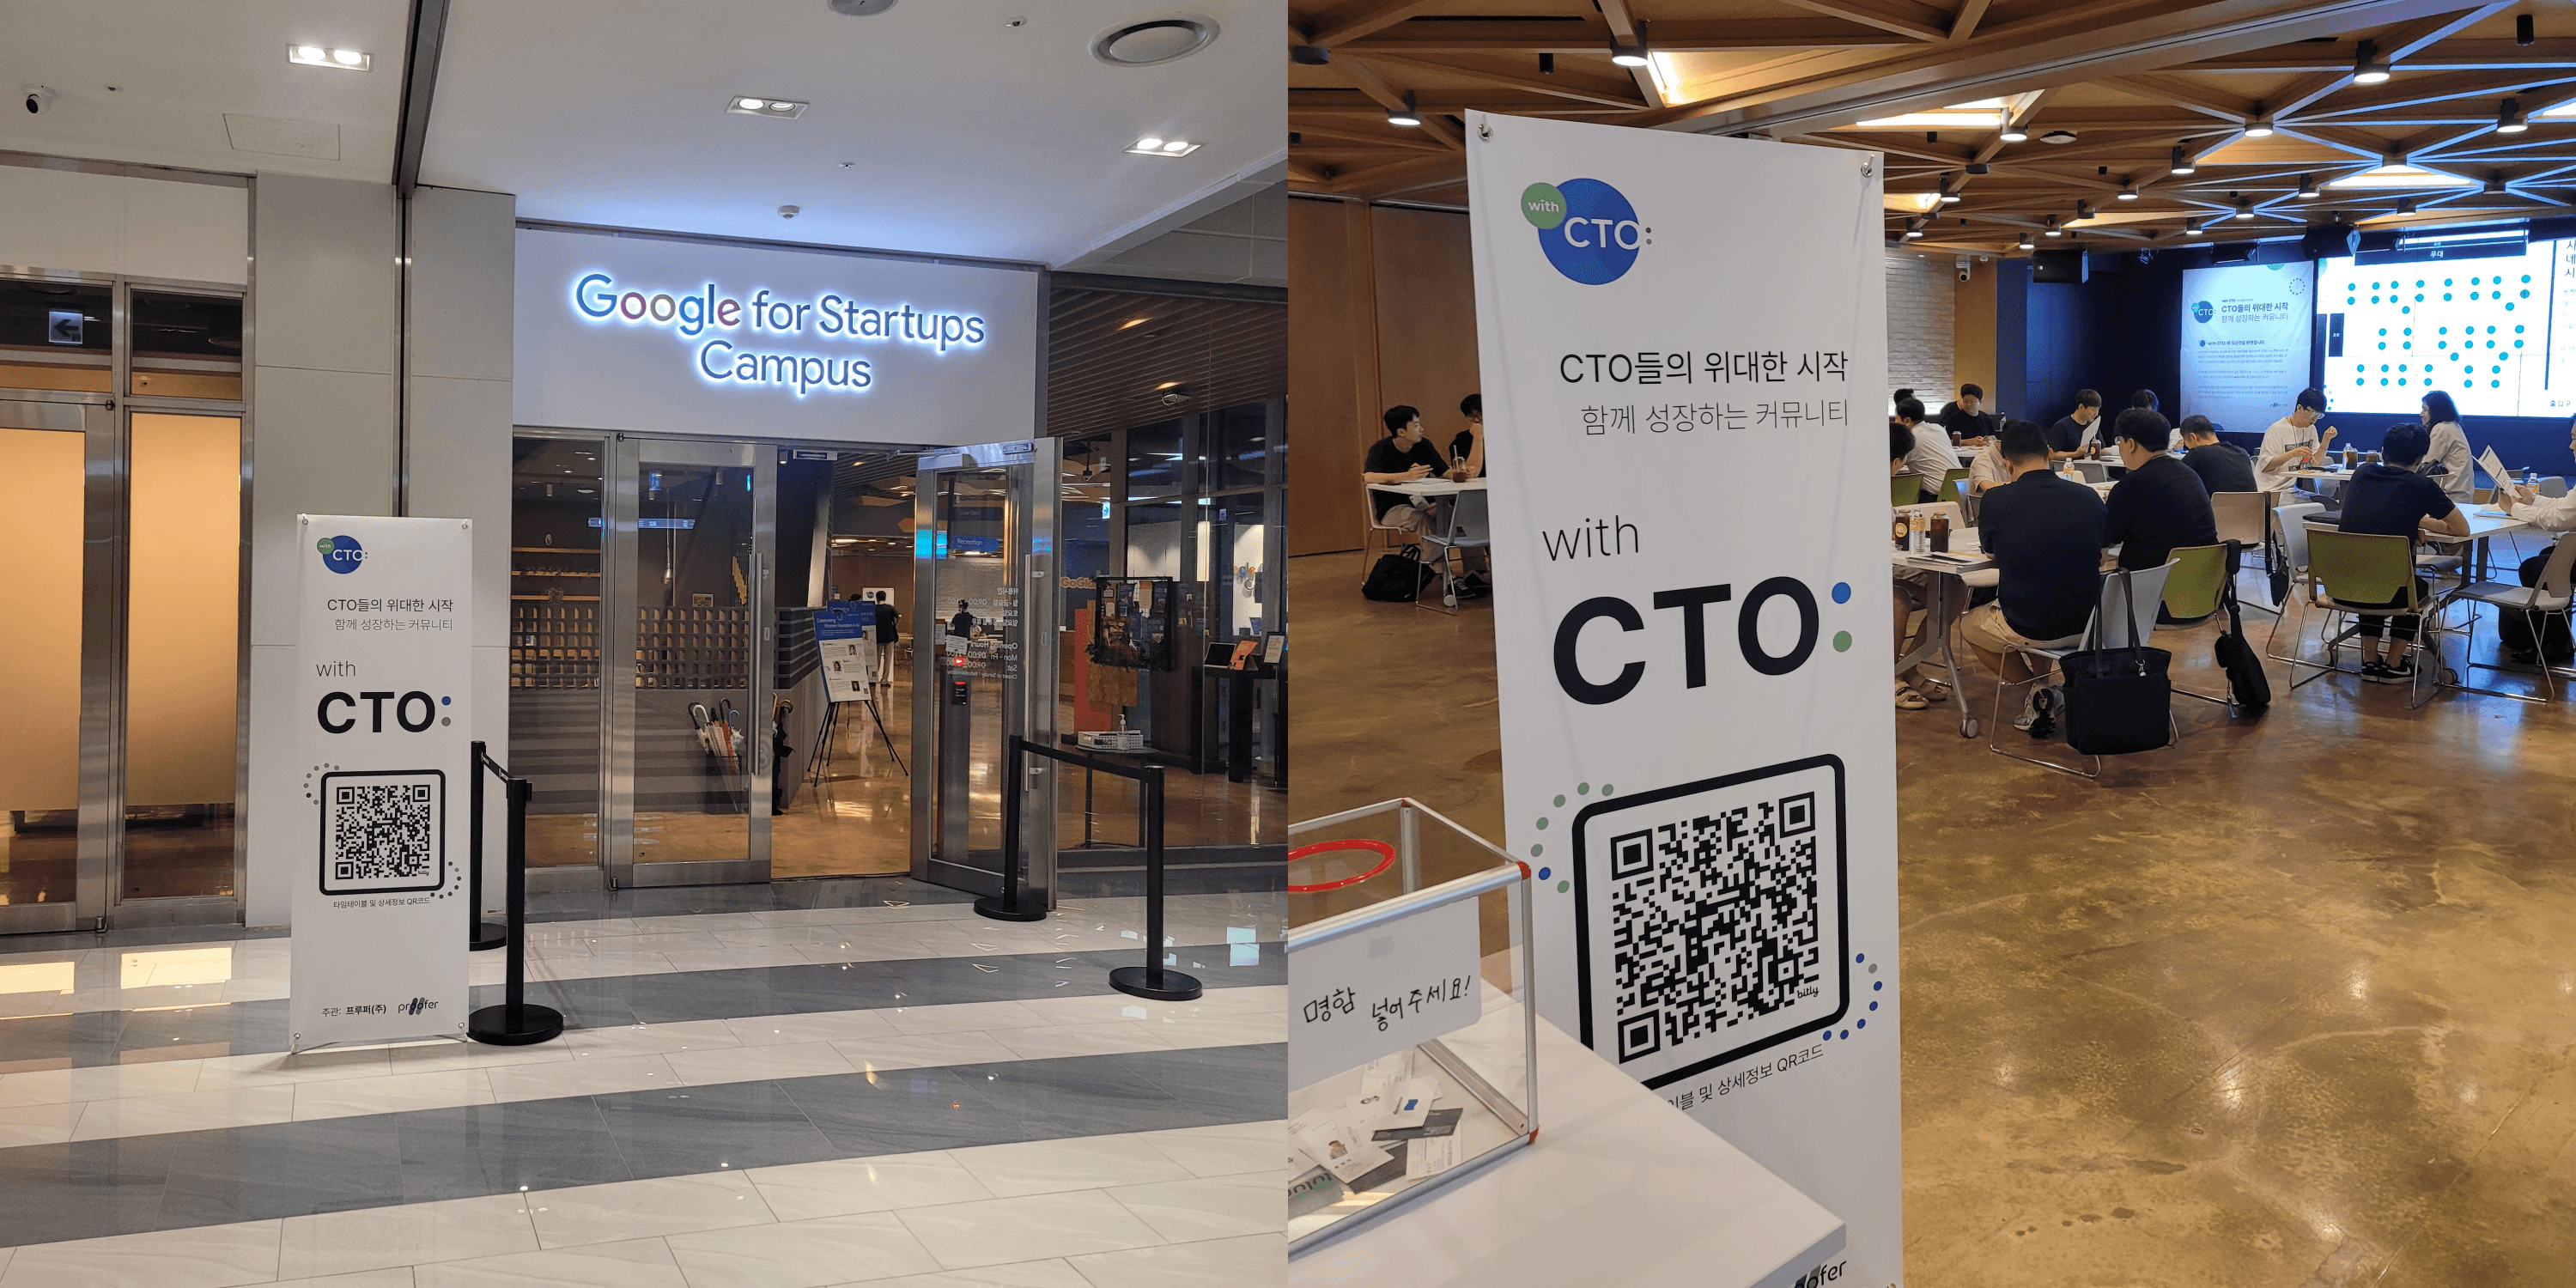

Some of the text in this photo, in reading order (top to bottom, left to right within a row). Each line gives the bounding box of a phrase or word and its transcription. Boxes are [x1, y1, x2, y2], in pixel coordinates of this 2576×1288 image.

[1528, 198, 1559, 212] with
[1564, 216, 1653, 251] CTO:
[574, 272, 986, 351] Google for Startups
[2221, 302, 2288, 313] CTO들의 위대한 시작
[2221, 314, 2234, 323] 함께
[2262, 313, 2288, 321] 커뮤니티
[701, 339, 872, 395] Campus
[1558, 350, 1849, 385] CTO들의 위대한 시작
[1580, 399, 1849, 436] 함께 성장하는 커뮤니티
[1542, 515, 1639, 562] with
[327, 599, 453, 612] CTO들의 위대한 시작
[335, 619, 453, 630] 함께 성장하는 커뮤니티
[1553, 575, 1852, 706] CTO:
[316, 660, 355, 677] with
[317, 690, 452, 734] CTO:
[333, 900, 368, 908] 타임테이블
[378, 898, 405, 907] 상세정보
[398, 997, 438, 1015] proofer
[1303, 987, 1356, 1023] 명함
[1796, 987, 1820, 999] bitly
[322, 1005, 386, 1017] 주관: 프루퍼(주)
[1699, 1084, 1713, 1103] 및
[1718, 1063, 1774, 1096] 상세정보
[1777, 1043, 1824, 1072] QR코드
